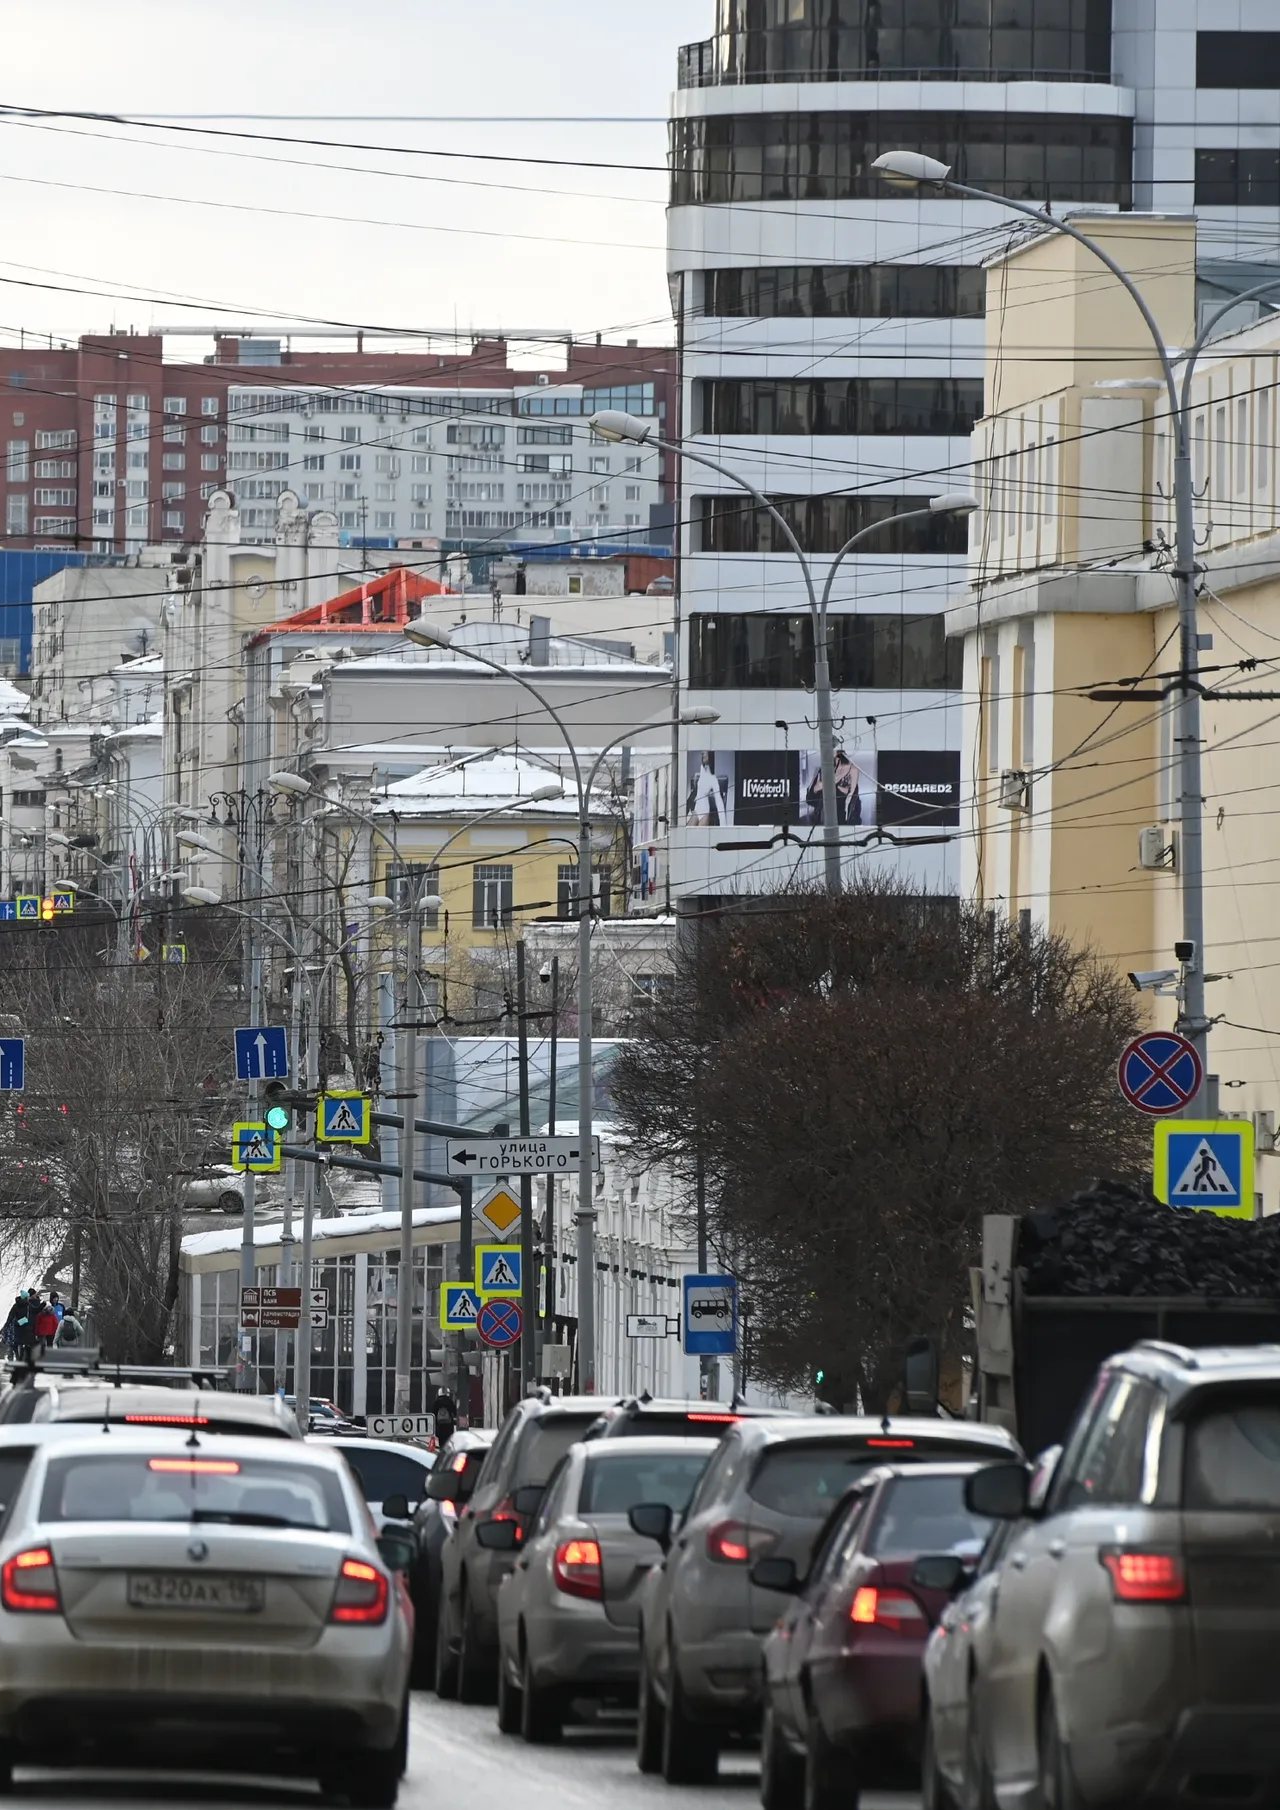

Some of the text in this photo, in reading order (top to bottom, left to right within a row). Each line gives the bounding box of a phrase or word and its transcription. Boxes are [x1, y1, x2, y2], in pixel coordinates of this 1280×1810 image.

[750, 783, 782, 794] Wolford
[884, 783, 953, 793] DSQUARED2
[499, 1143, 547, 1156] улица
[479, 1154, 567, 1169] ГОРЬКОГО
[263, 1289, 276, 1297] ПСБ
[373, 1418, 429, 1434] СТОП
